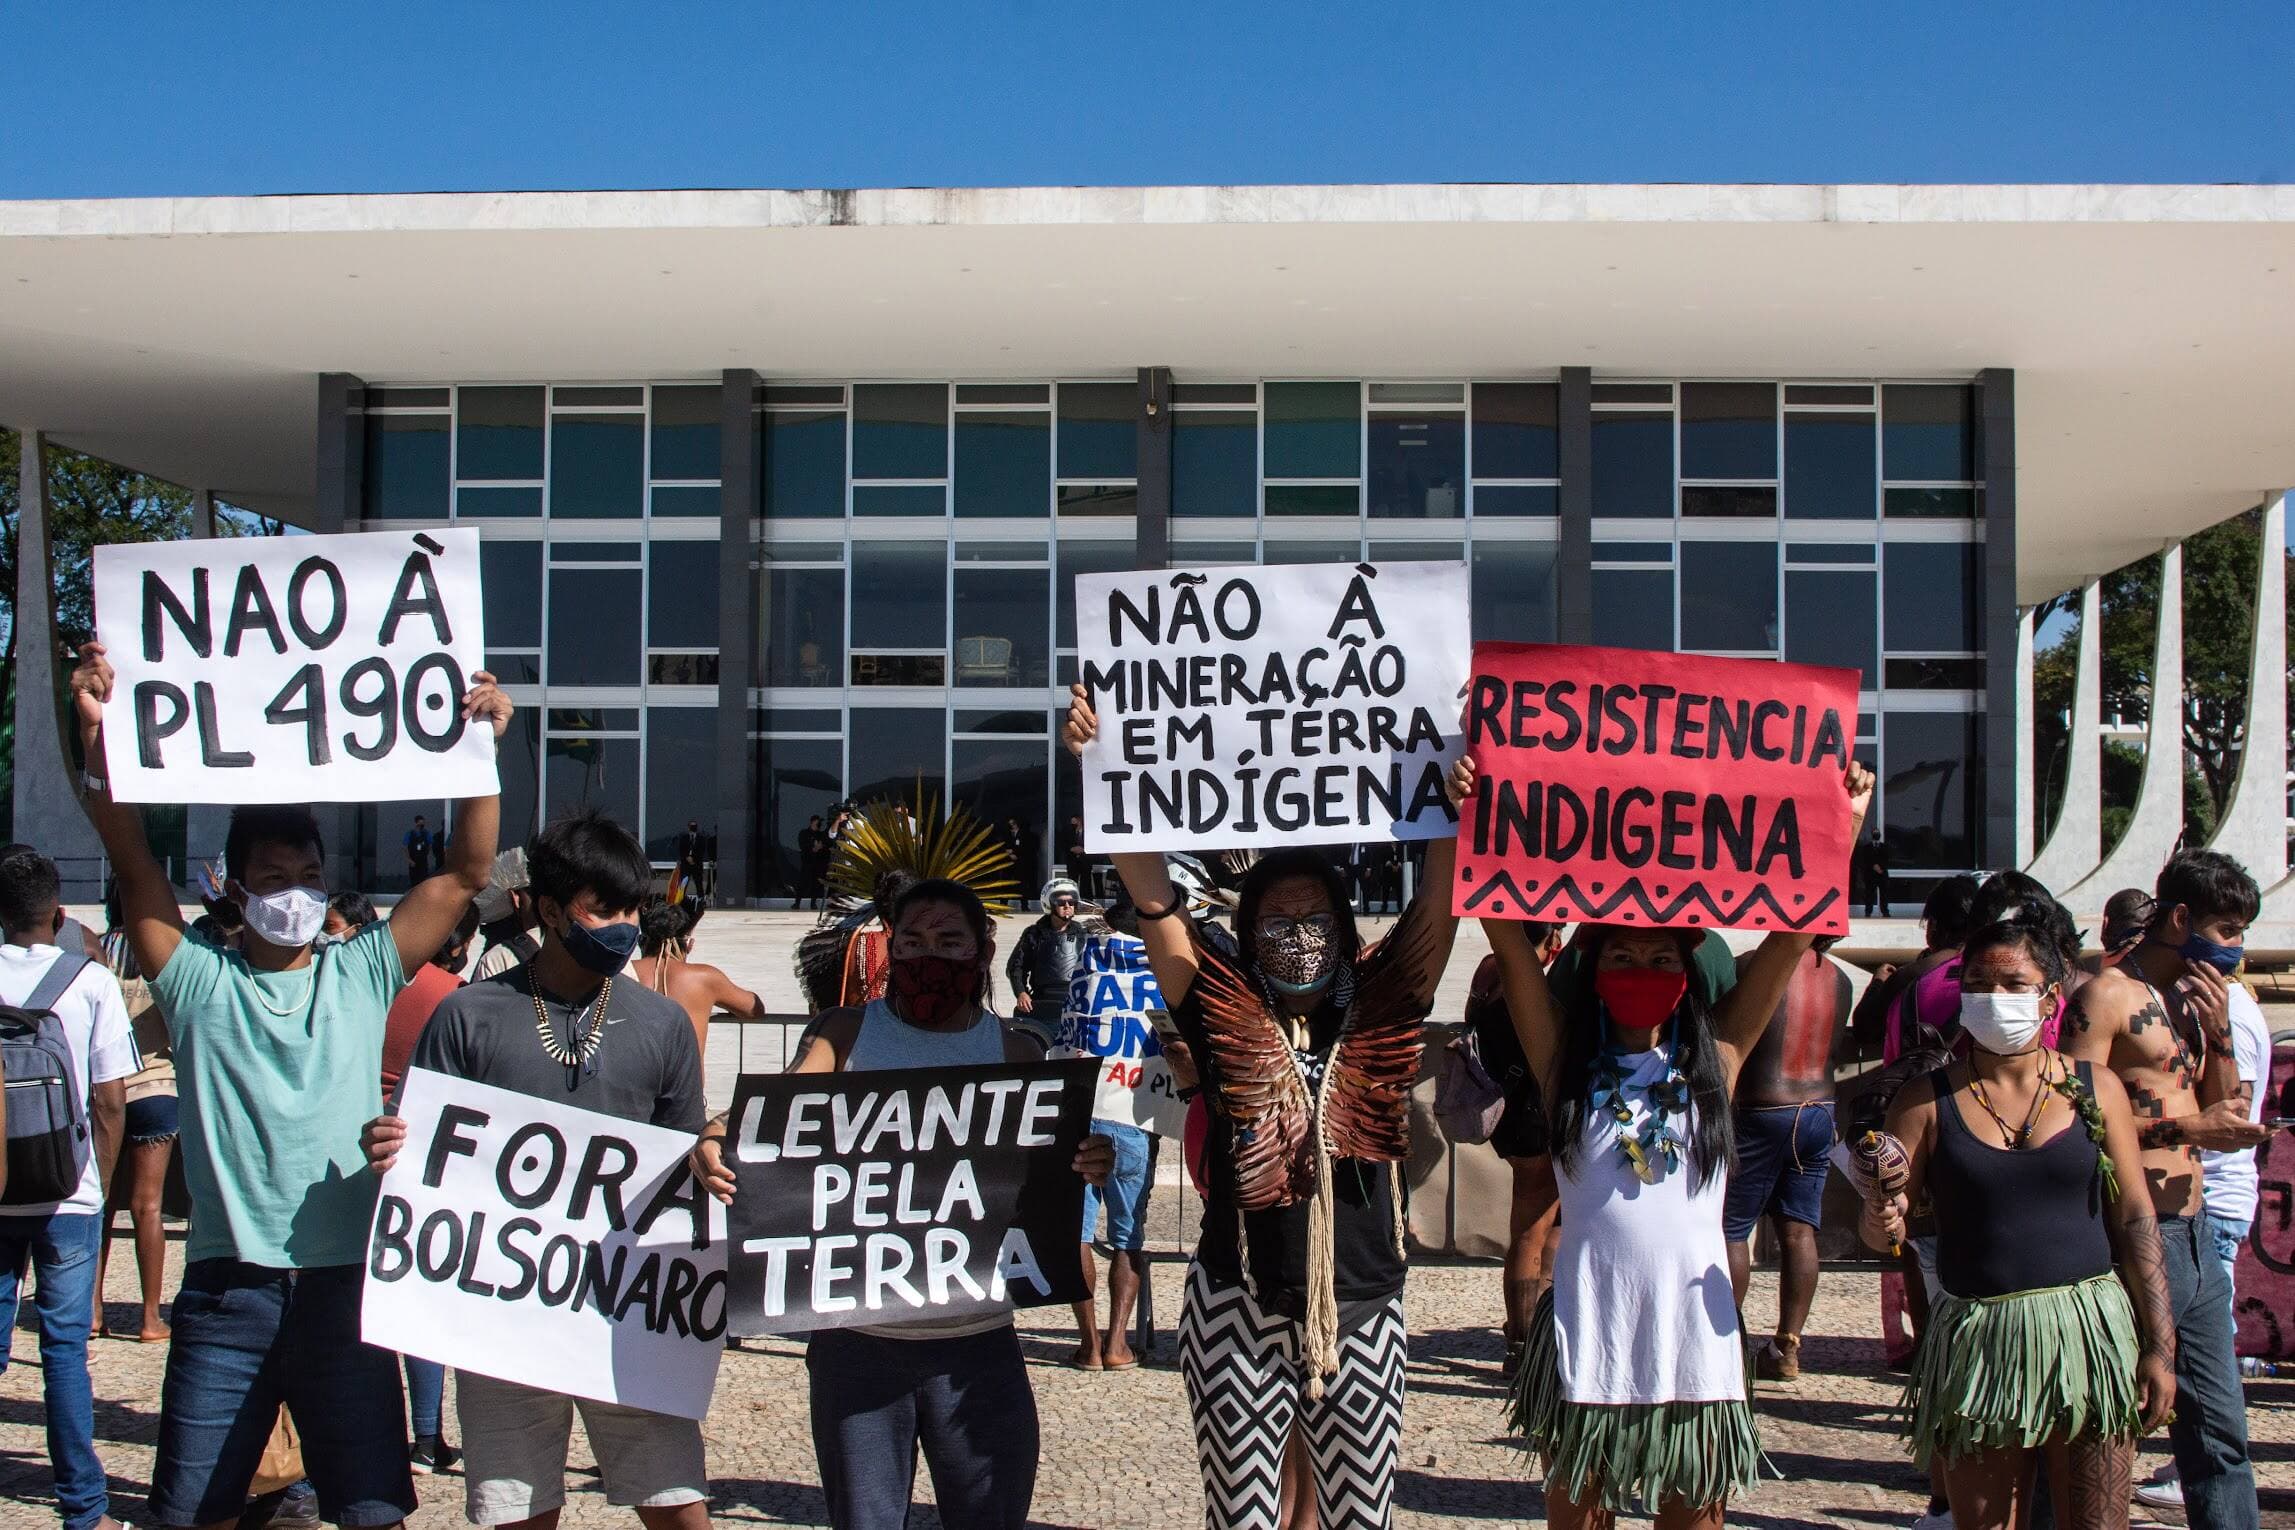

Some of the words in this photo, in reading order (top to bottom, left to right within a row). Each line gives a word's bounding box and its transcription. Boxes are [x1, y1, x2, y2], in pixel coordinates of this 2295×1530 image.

[142, 555, 347, 662] NAO
[379, 533, 453, 646] À
[1109, 573, 1261, 647] NÃO
[1327, 563, 1385, 639] À
[134, 681, 255, 769] PL
[265, 652, 466, 765] 490
[1084, 634, 1406, 715] MINERAÇÃO
[1122, 712, 1215, 765] EM
[1246, 706, 1445, 757] TERRA
[1469, 675, 1848, 770] RESISTENCIA
[1101, 749, 1460, 834] INDÍGENA
[1473, 775, 1806, 880] INDIGENA
[736, 1079, 1065, 1163] LEVANTE
[422, 1103, 710, 1252] FORA
[812, 1159, 986, 1232] PELA
[370, 1194, 728, 1342] BOLSONARO
[743, 1227, 1053, 1317] TERRA
